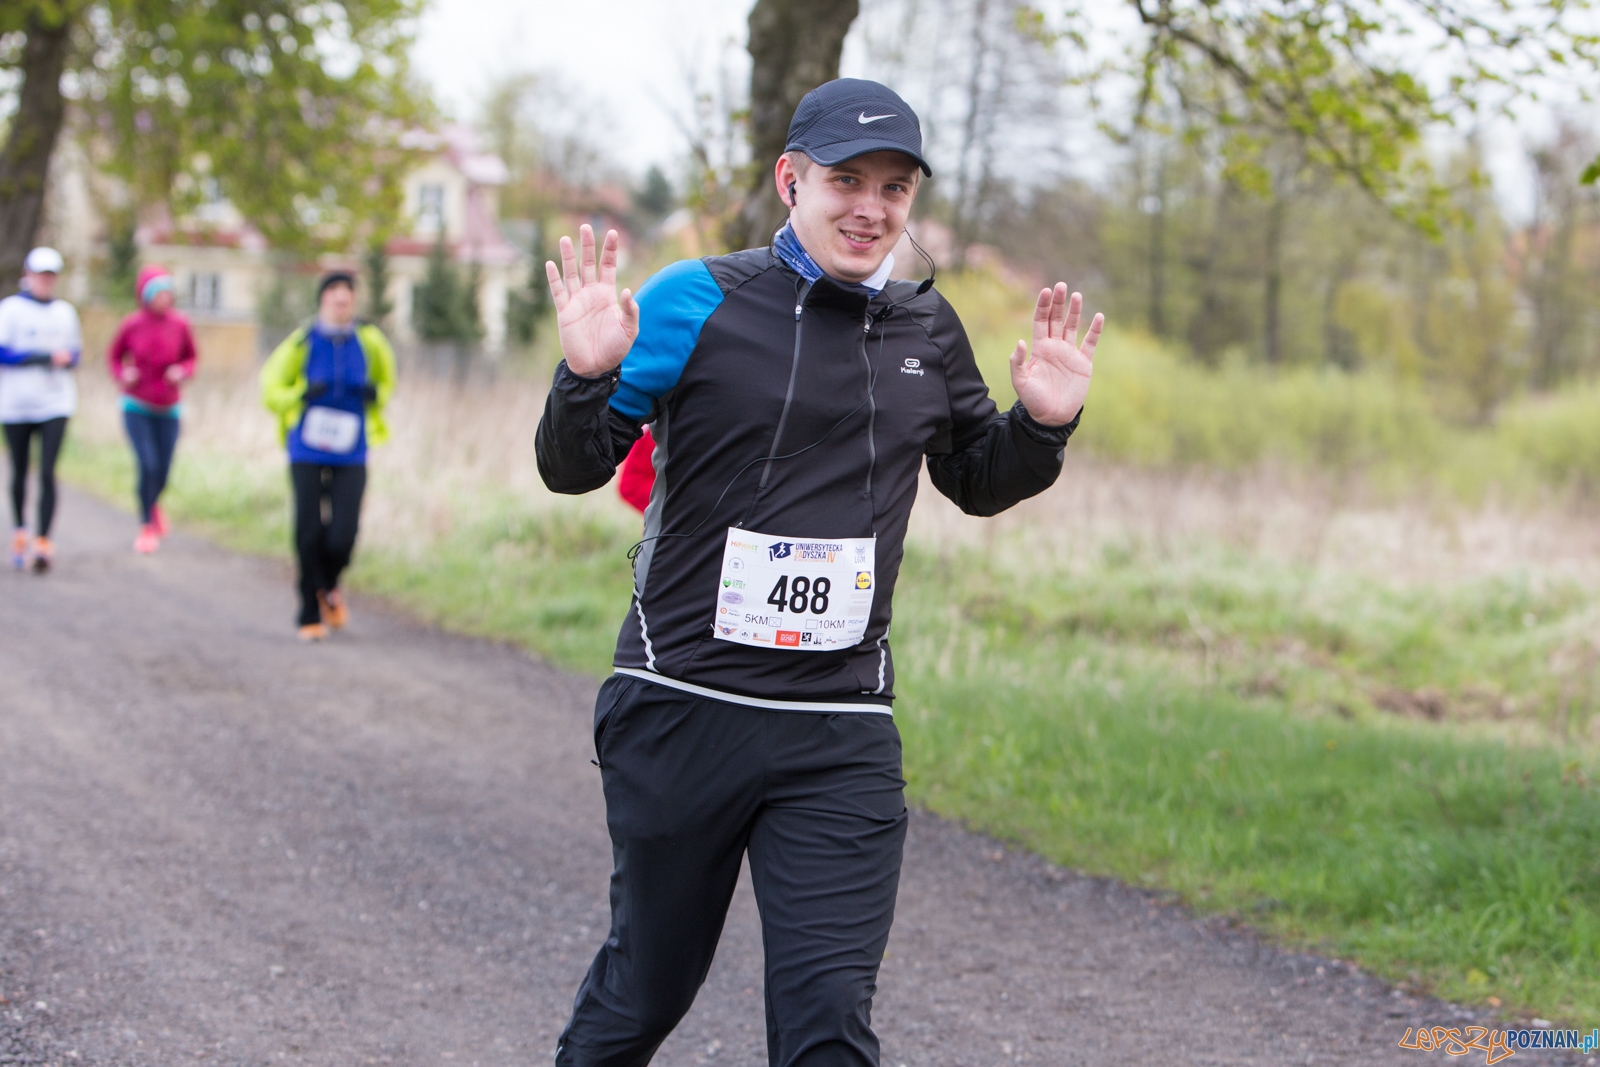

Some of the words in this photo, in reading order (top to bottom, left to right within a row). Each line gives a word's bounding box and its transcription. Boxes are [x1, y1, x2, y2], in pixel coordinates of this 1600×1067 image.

[795, 542, 843, 552] UNIWERSYTECKA
[794, 550, 827, 560] ZADYSZKA
[766, 574, 832, 615] 488
[744, 613, 769, 626] 5KM
[818, 619, 846, 629] 10KM
